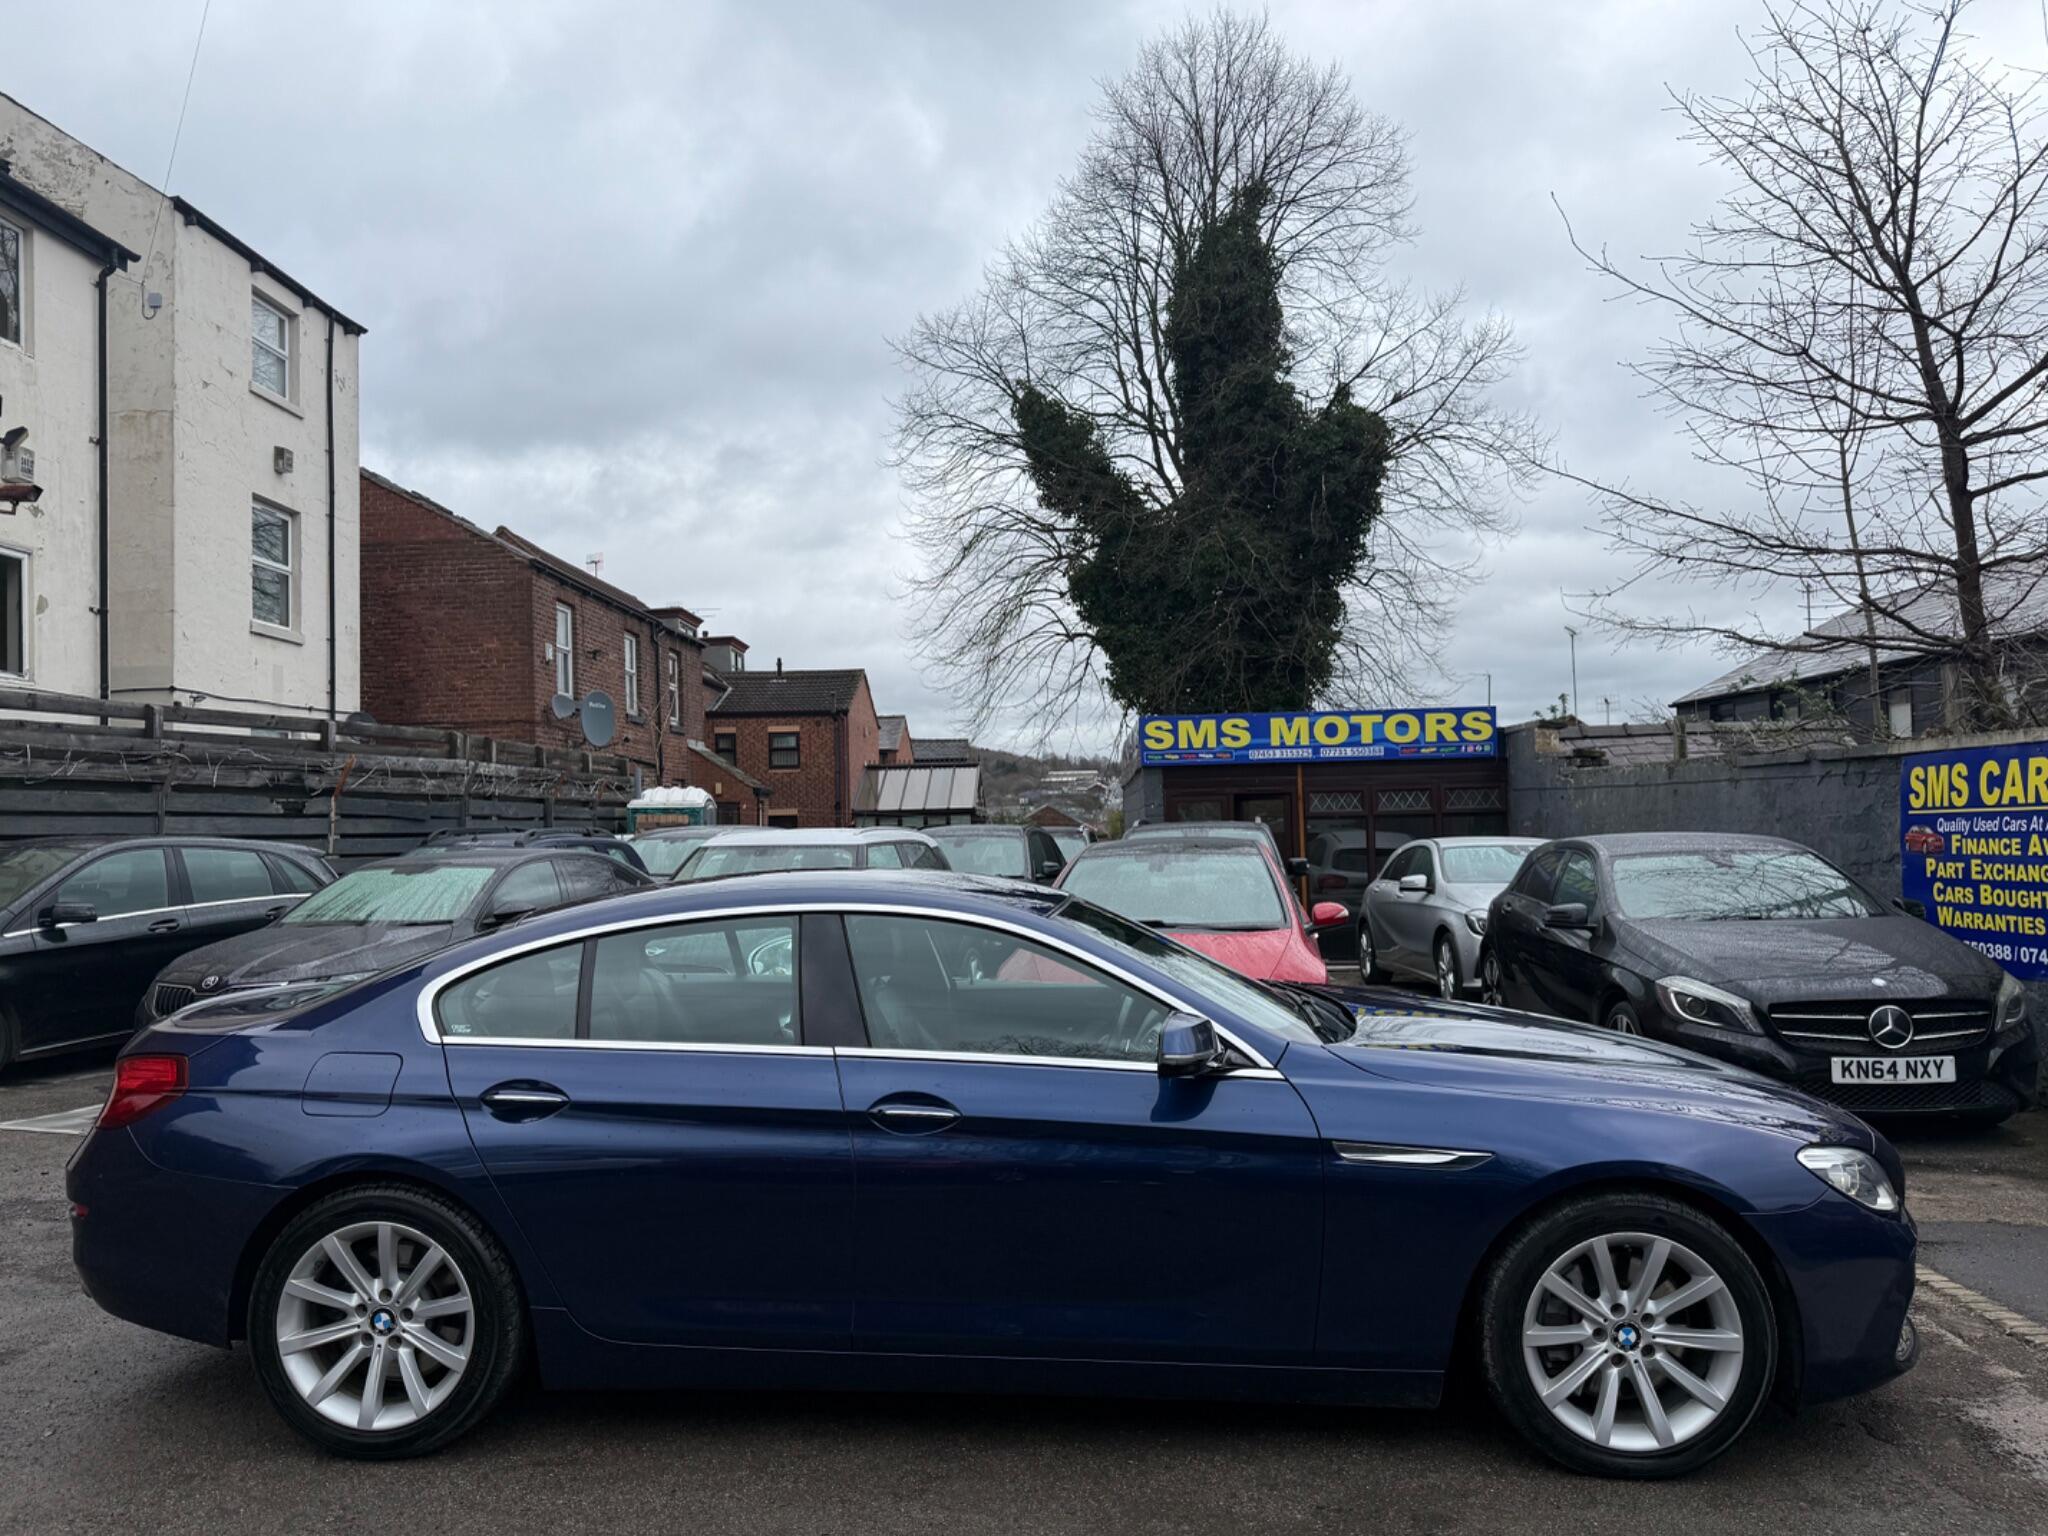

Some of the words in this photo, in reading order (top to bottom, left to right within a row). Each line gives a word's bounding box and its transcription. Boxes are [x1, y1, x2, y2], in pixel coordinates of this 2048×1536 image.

[1143, 717, 1252, 750] SMS
[1269, 711, 1494, 747] MOTORS
[1908, 762, 1970, 809] SMS
[1979, 756, 2048, 806] CAR
[1937, 816, 1971, 835] Quality
[1973, 816, 2000, 832] Used
[2001, 815, 2028, 832] Cars
[2029, 814, 2044, 831] At
[1951, 833, 2022, 855] FINANCE
[1925, 858, 1965, 878] PART
[1933, 882, 1974, 904] CARS
[1937, 905, 2046, 936] WARRANTIES
[1841, 1059, 1899, 1079] KN64
[1905, 1059, 1944, 1079] NXY
